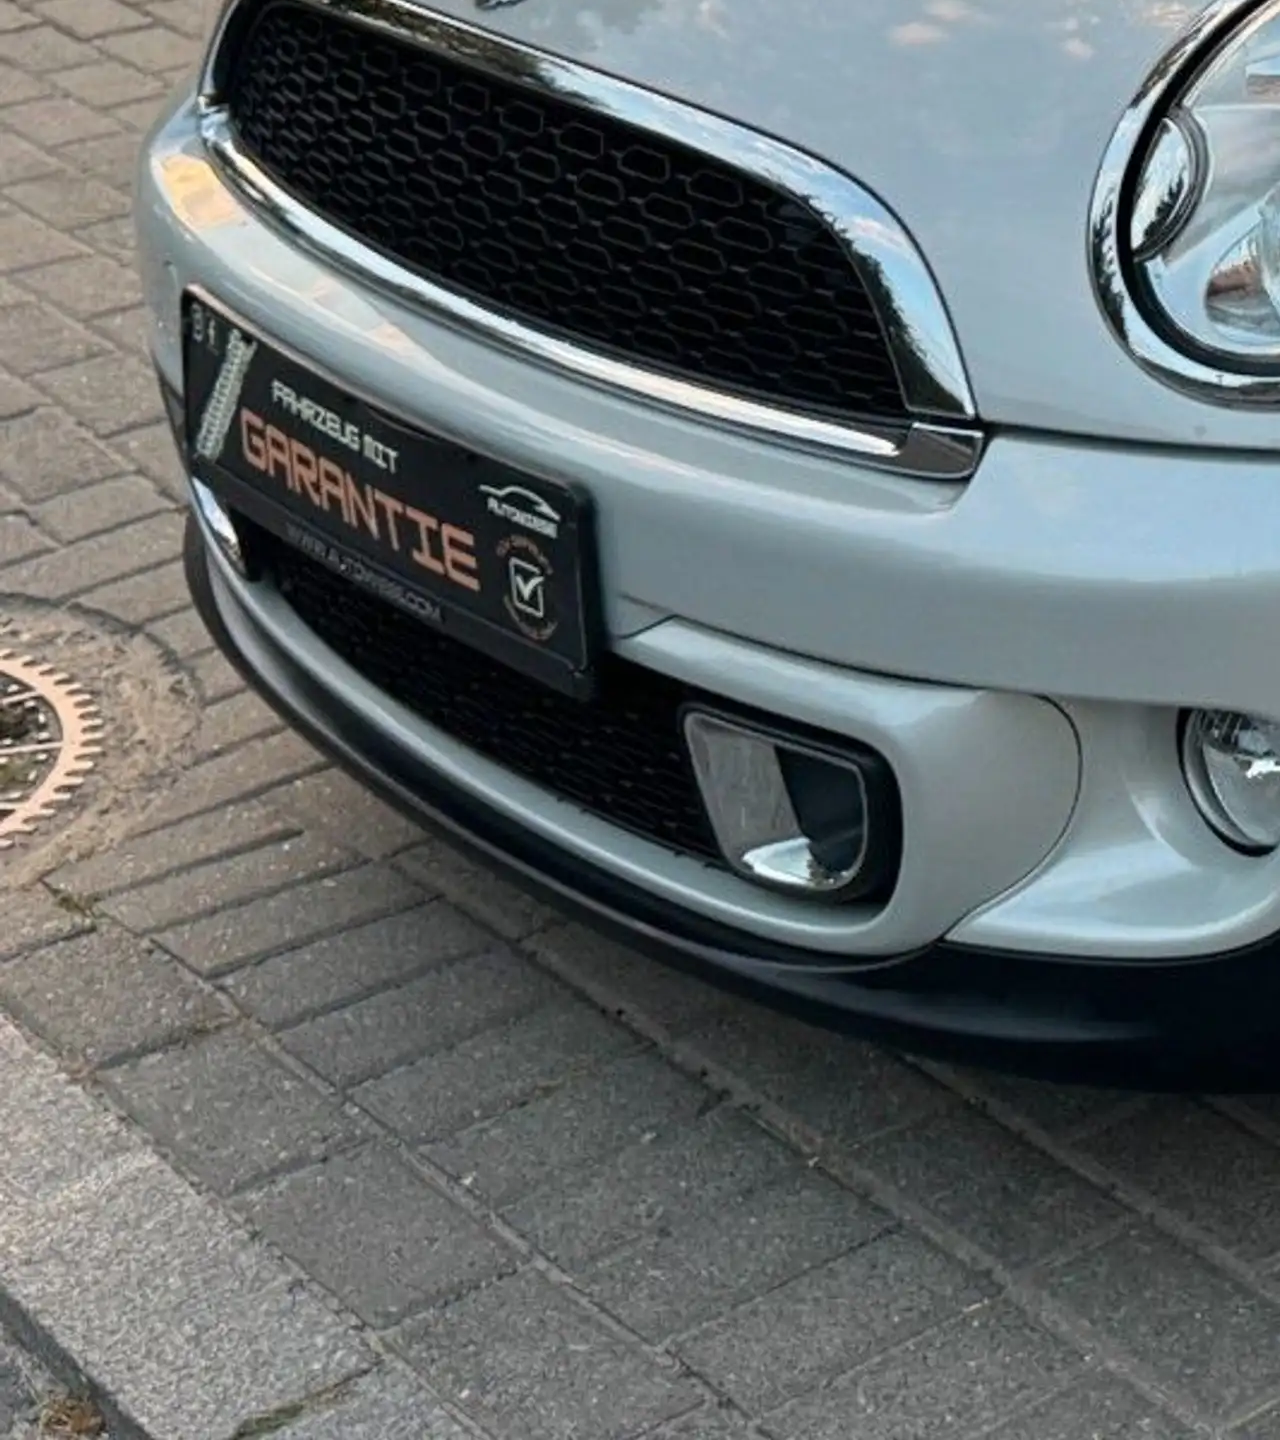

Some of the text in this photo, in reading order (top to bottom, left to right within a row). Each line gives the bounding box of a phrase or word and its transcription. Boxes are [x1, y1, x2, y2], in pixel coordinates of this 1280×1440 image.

[270, 378, 361, 451] FAHRZEUG
[362, 433, 400, 474] MIT
[240, 407, 482, 594] GARANTIE
